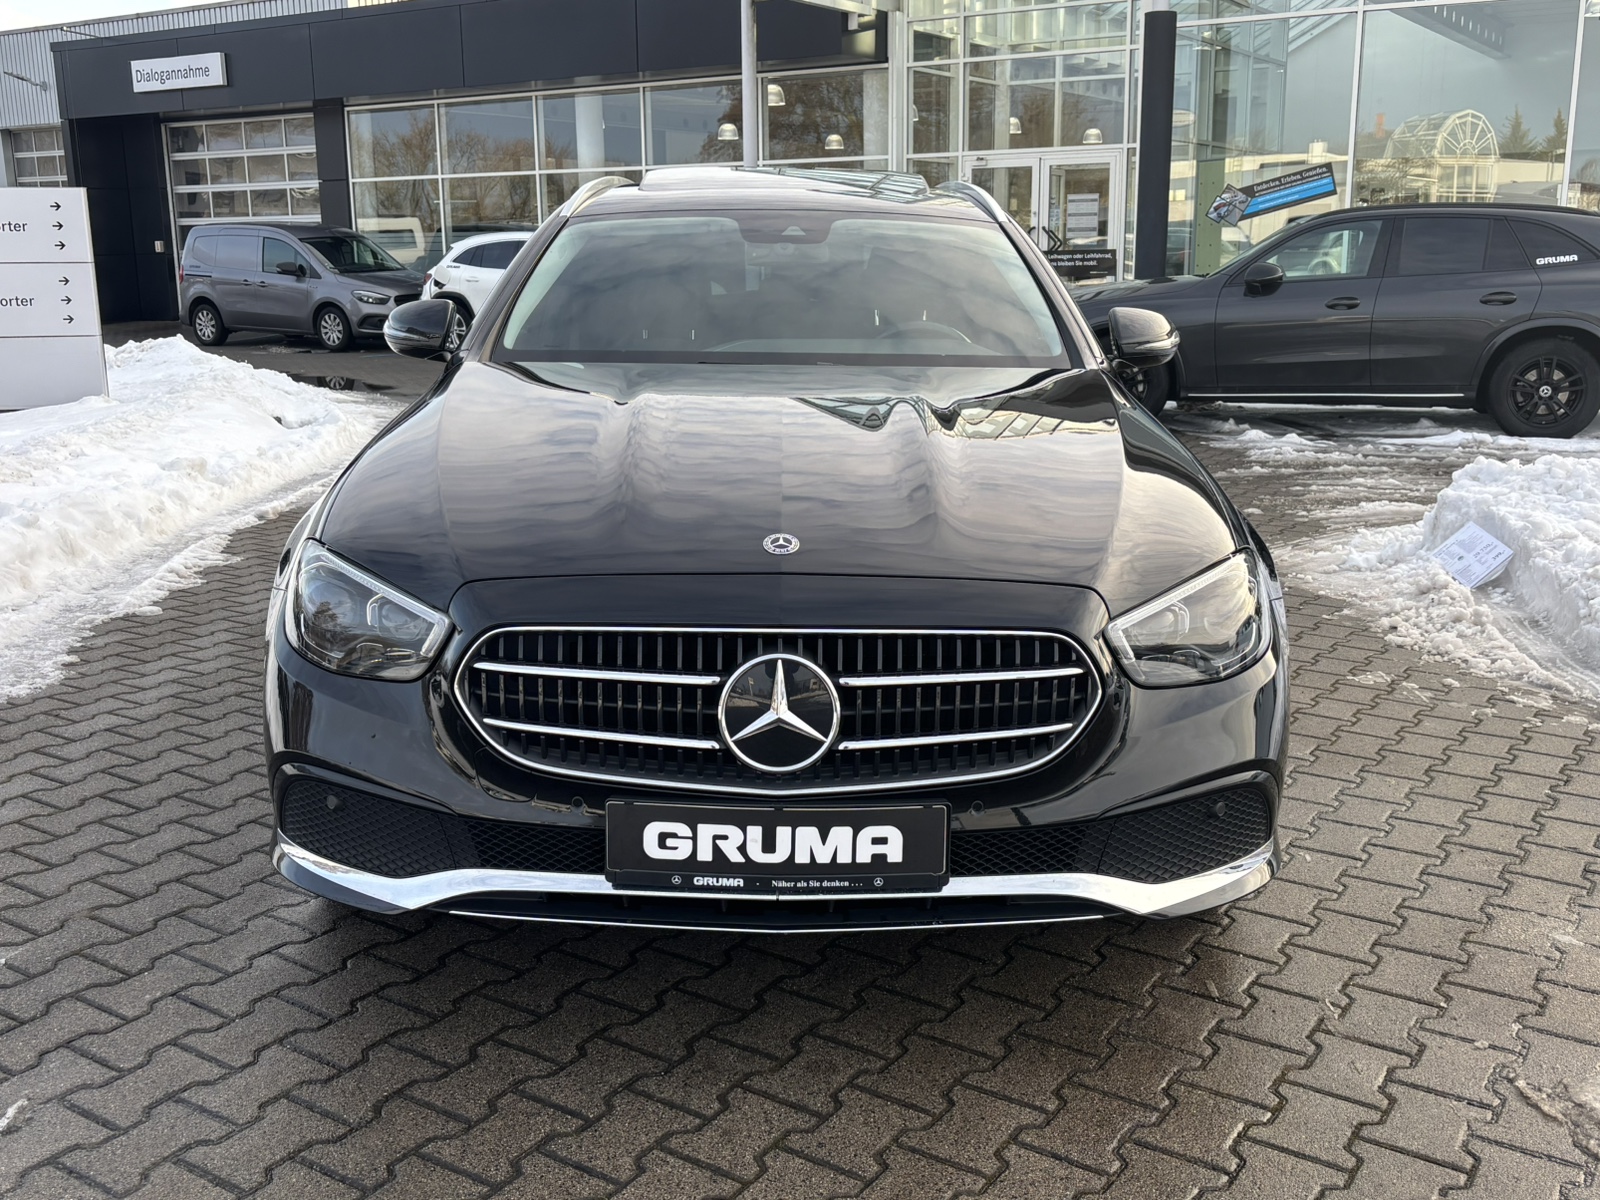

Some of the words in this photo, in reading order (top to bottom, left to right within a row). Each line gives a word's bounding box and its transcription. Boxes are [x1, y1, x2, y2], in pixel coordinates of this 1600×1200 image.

[135, 65, 210, 84] Dialogannahme
[1253, 179, 1280, 191] Entdecken.
[1280, 172, 1302, 184] Erleben.
[1302, 166, 1328, 178] Genießen.
[0, 221, 27, 232] rter
[1084, 252, 1112, 260] Leihfahrrad,
[1536, 254, 1578, 265] GRUMA
[642, 821, 904, 865] GRUMA
[693, 876, 744, 887] GRUMA
[822, 879, 850, 887] denken
